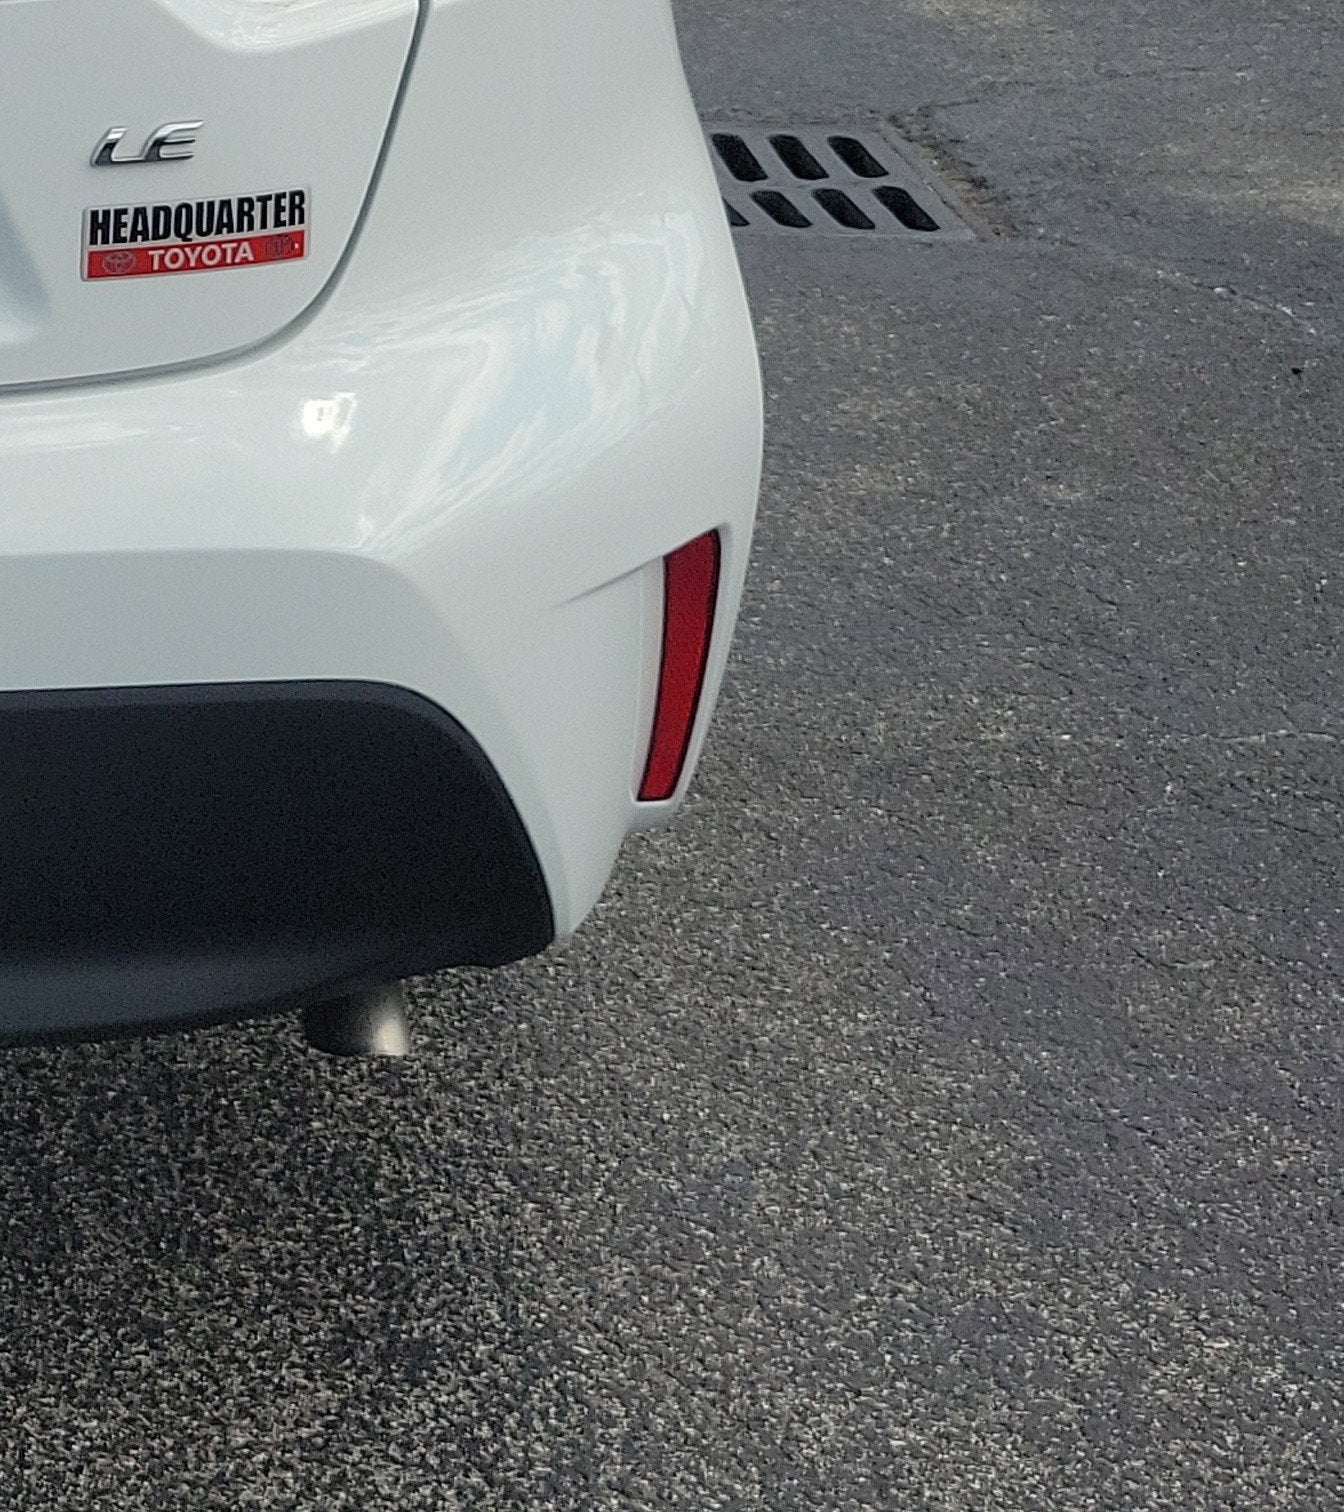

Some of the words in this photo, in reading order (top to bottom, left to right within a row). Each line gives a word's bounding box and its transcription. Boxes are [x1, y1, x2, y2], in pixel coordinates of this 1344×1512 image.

[90, 119, 204, 167] LE
[88, 189, 306, 246] HEADQUARTER
[148, 241, 254, 271] TOYOTA
